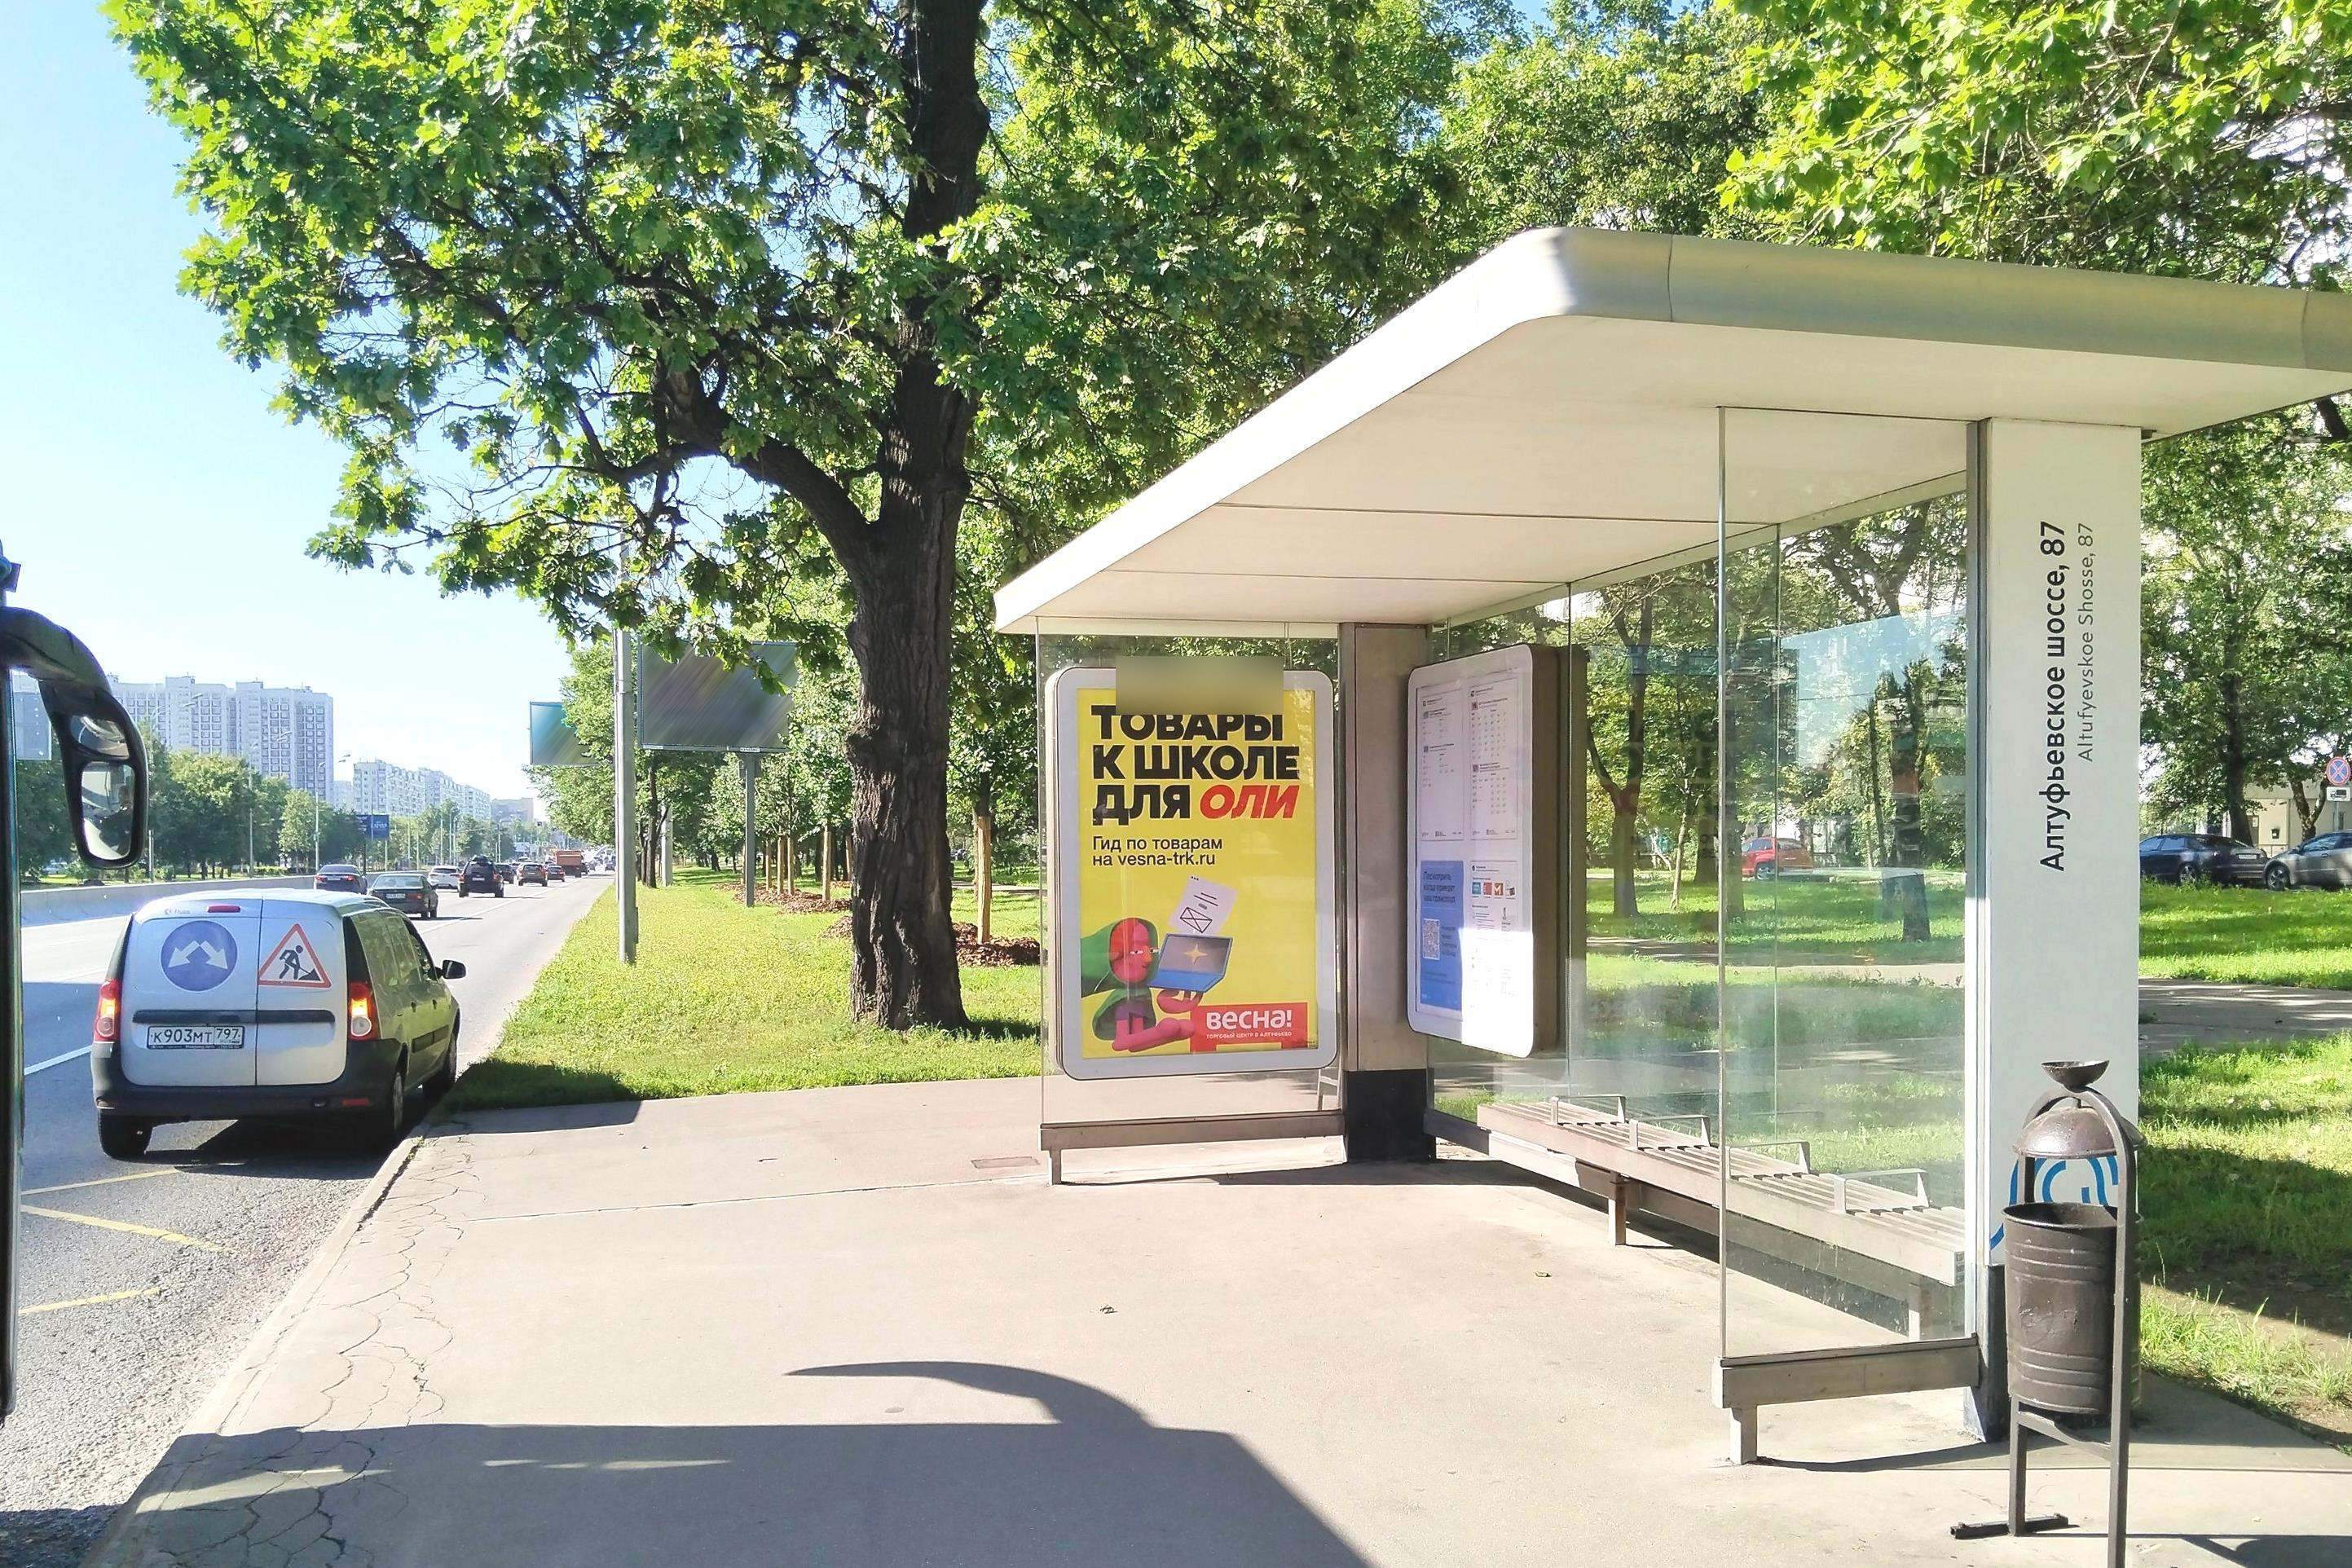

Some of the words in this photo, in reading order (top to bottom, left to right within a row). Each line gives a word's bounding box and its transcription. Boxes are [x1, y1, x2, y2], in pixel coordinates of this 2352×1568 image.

[2040, 521, 2065, 556] 87
[2077, 522, 2093, 547] 87
[2077, 553, 2096, 625] Shosse,
[2046, 565, 2070, 657] шоссе,
[2077, 632, 2097, 762] Altufyevskoe
[1091, 705, 1283, 741] ТОВАРЫ
[1093, 744, 1125, 779] К
[1134, 745, 1299, 780] ШКОЛЕ
[2038, 667, 2071, 871] Алтуфьевское
[1092, 784, 1191, 826] ДЛЯ
[1200, 784, 1300, 819] ОЛИ
[1092, 836, 1121, 852] Гид
[1126, 839, 1147, 850] по
[1152, 838, 1222, 852] товарам
[1092, 854, 1112, 866] на
[1117, 852, 1216, 866] vesna-trk.ru
[216, 1028, 239, 1040] 797
